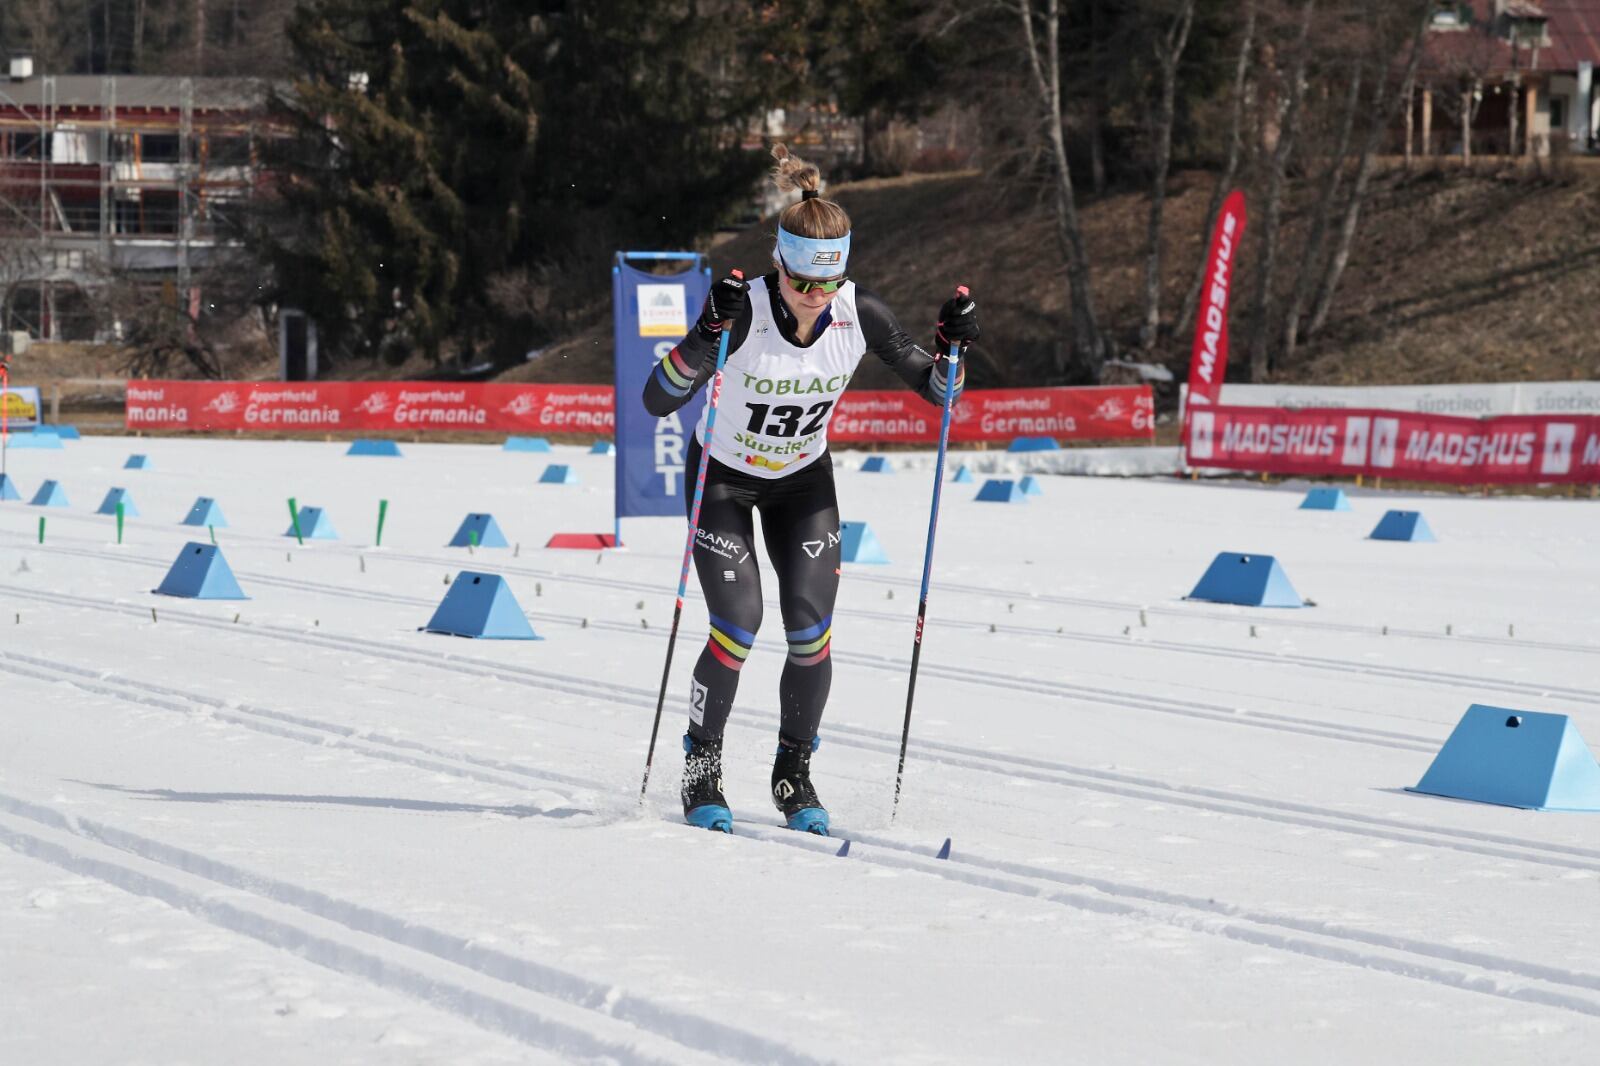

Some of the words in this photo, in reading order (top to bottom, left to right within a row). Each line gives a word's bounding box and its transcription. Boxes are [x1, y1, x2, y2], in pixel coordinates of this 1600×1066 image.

[1198, 211, 1237, 384] MADSHUS
[249, 389, 318, 403] Apparthotel
[399, 389, 466, 403] Apparthotel
[545, 392, 613, 407] Apparthotel
[837, 398, 904, 413] Apparthotel
[983, 396, 1051, 411] Apparthotel
[128, 404, 188, 422] mania
[244, 404, 340, 424] Germania
[394, 404, 487, 424] Germania
[653, 341, 685, 497] SART
[745, 400, 833, 438] 132
[980, 412, 1076, 433] Germania
[833, 415, 926, 434] Germania
[1221, 421, 1337, 456] MADSHUS
[1404, 430, 1536, 466] MADSHUS
